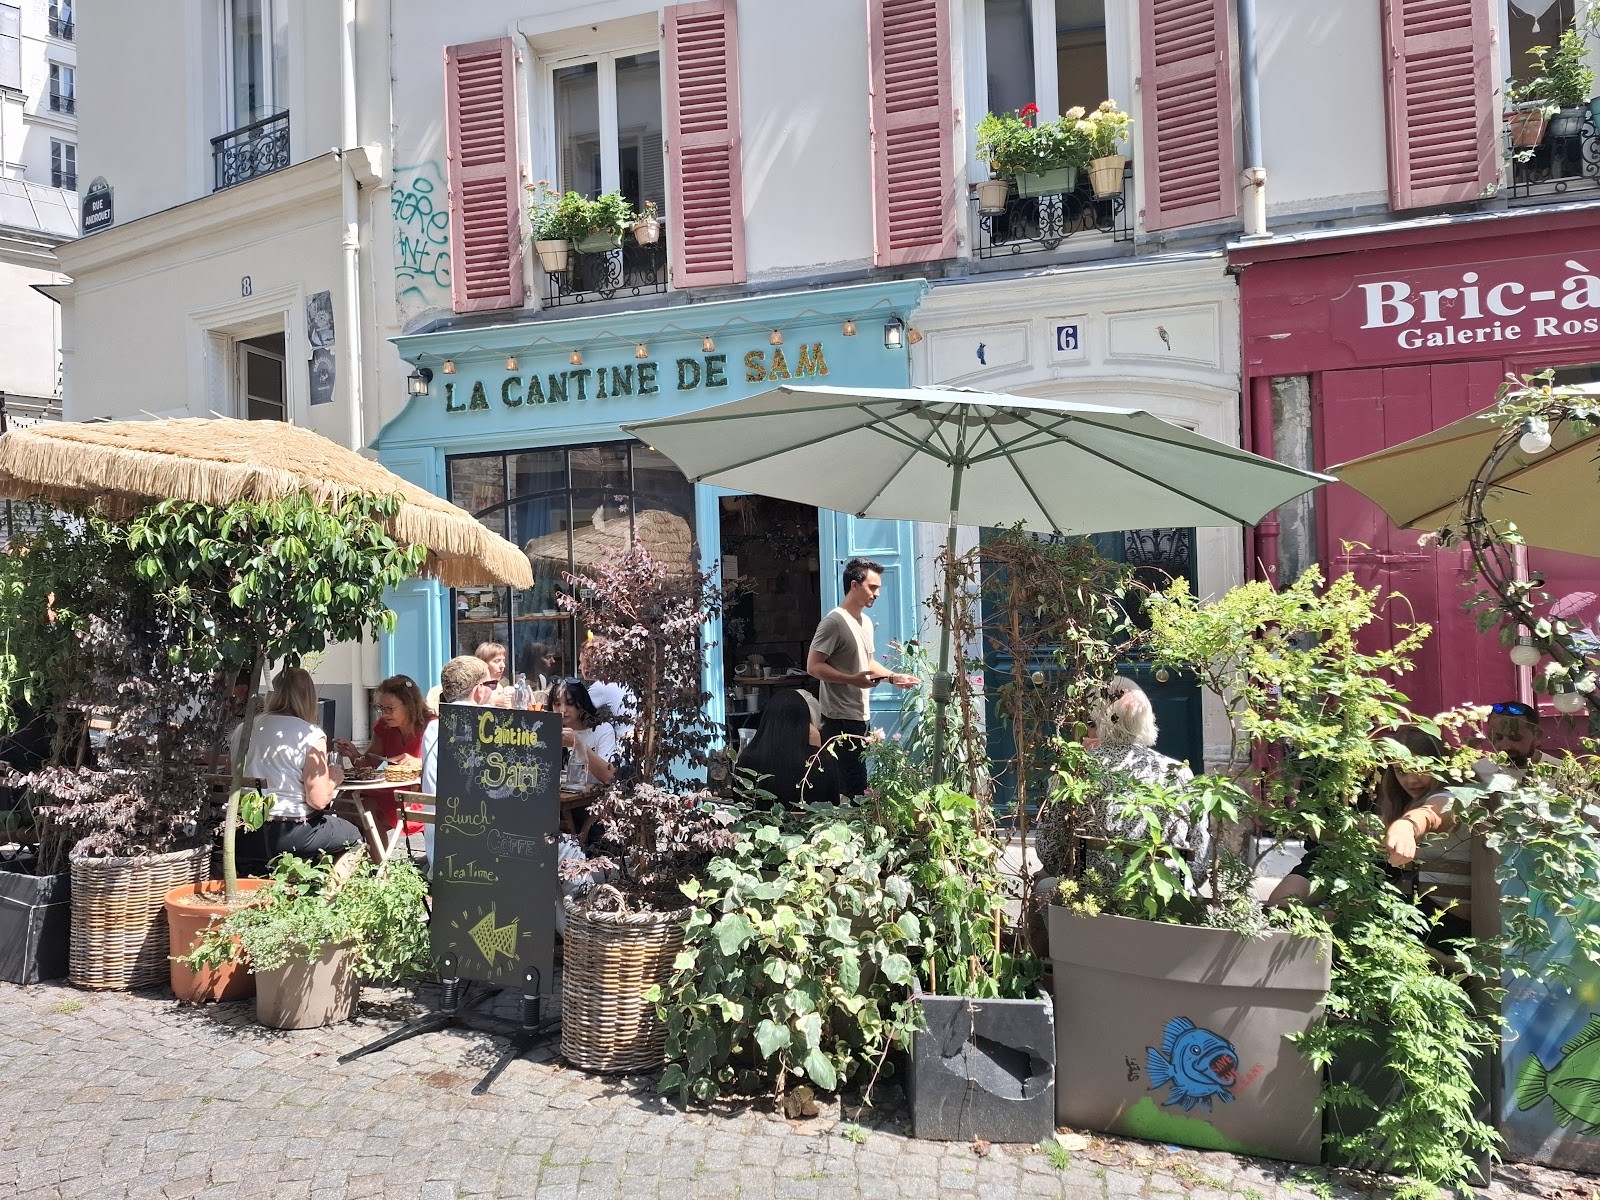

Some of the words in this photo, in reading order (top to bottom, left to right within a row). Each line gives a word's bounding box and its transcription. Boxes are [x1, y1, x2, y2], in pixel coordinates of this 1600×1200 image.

[85, 209, 111, 226] ANDROUET
[92, 199, 104, 211] RUE
[242, 276, 251, 296] 8
[1358, 259, 1600, 330] Bric-à
[1060, 327, 1076, 350] 6
[1397, 321, 1522, 350] Galerie
[1534, 316, 1599, 338] Ros
[445, 380, 491, 412] LA
[501, 362, 660, 409] CANTINE
[676, 354, 729, 391] DE
[744, 342, 830, 383] SAM
[478, 710, 538, 747] Cantine
[484, 752, 538, 789] Sam
[444, 796, 492, 826] Lunch
[445, 853, 466, 879] Tea
